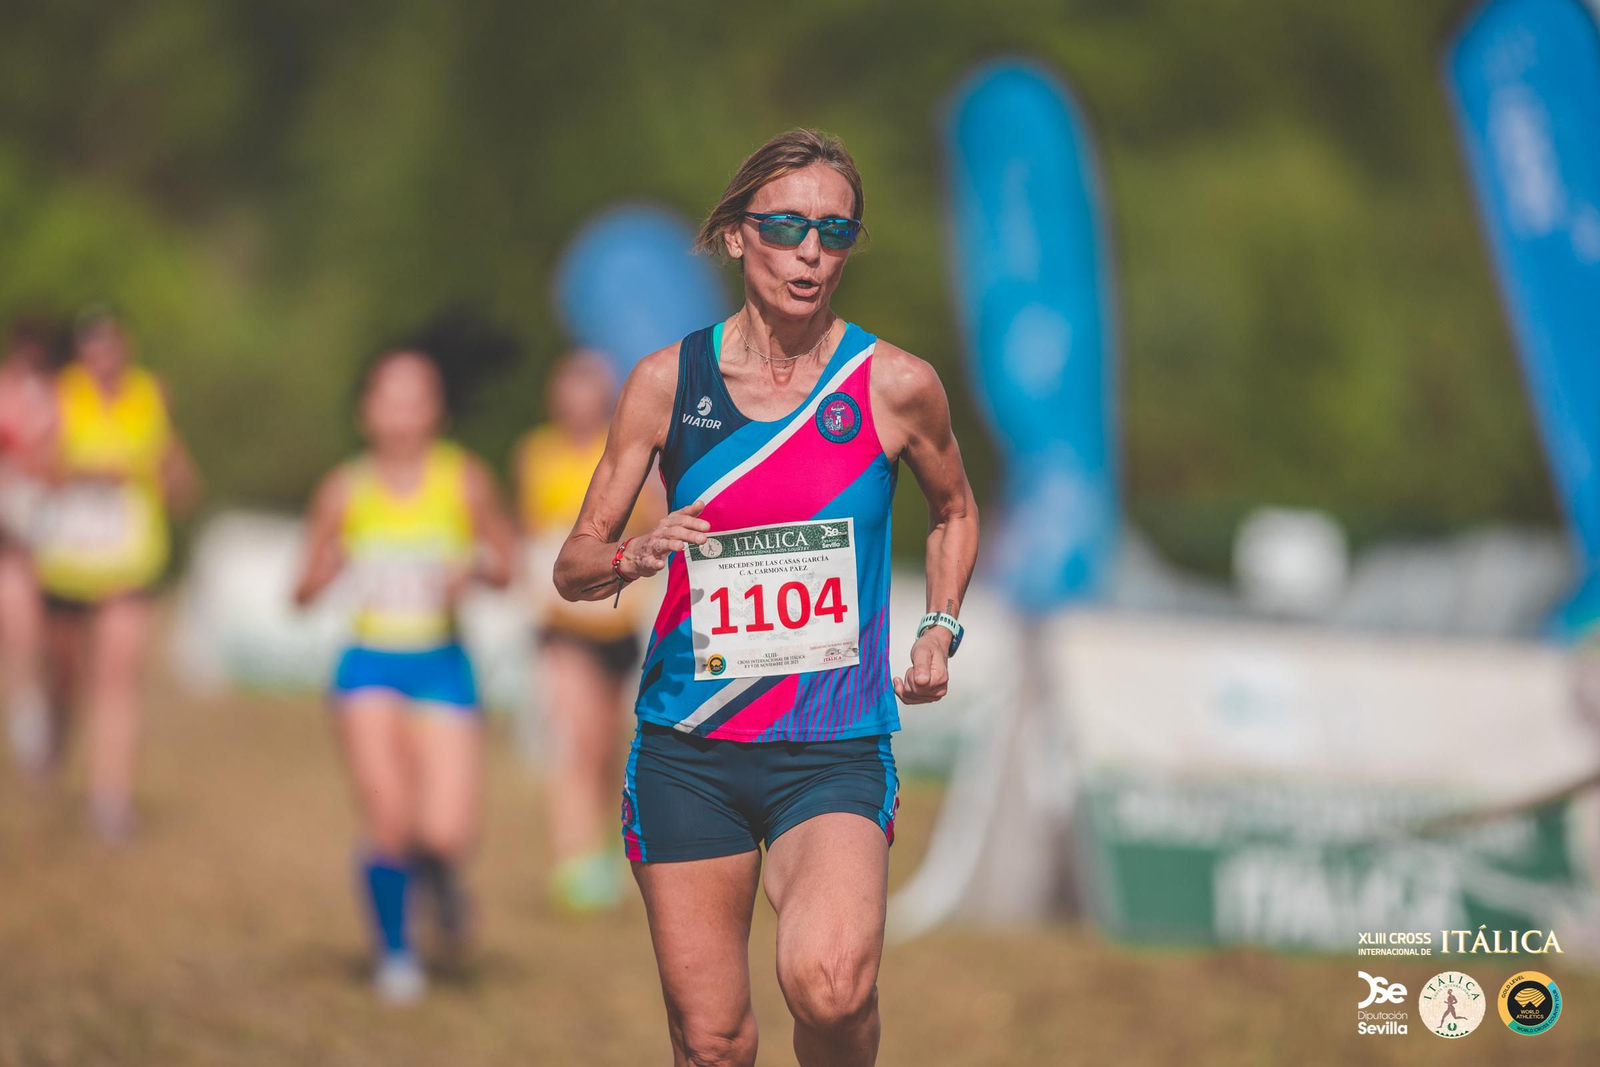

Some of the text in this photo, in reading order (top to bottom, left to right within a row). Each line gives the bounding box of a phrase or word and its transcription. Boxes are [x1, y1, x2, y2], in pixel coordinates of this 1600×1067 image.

[682, 413, 722, 430] VIATOR
[732, 530, 809, 552] ITÁLICA
[718, 561, 755, 570] MERCEDES
[710, 576, 848, 635] 1104
